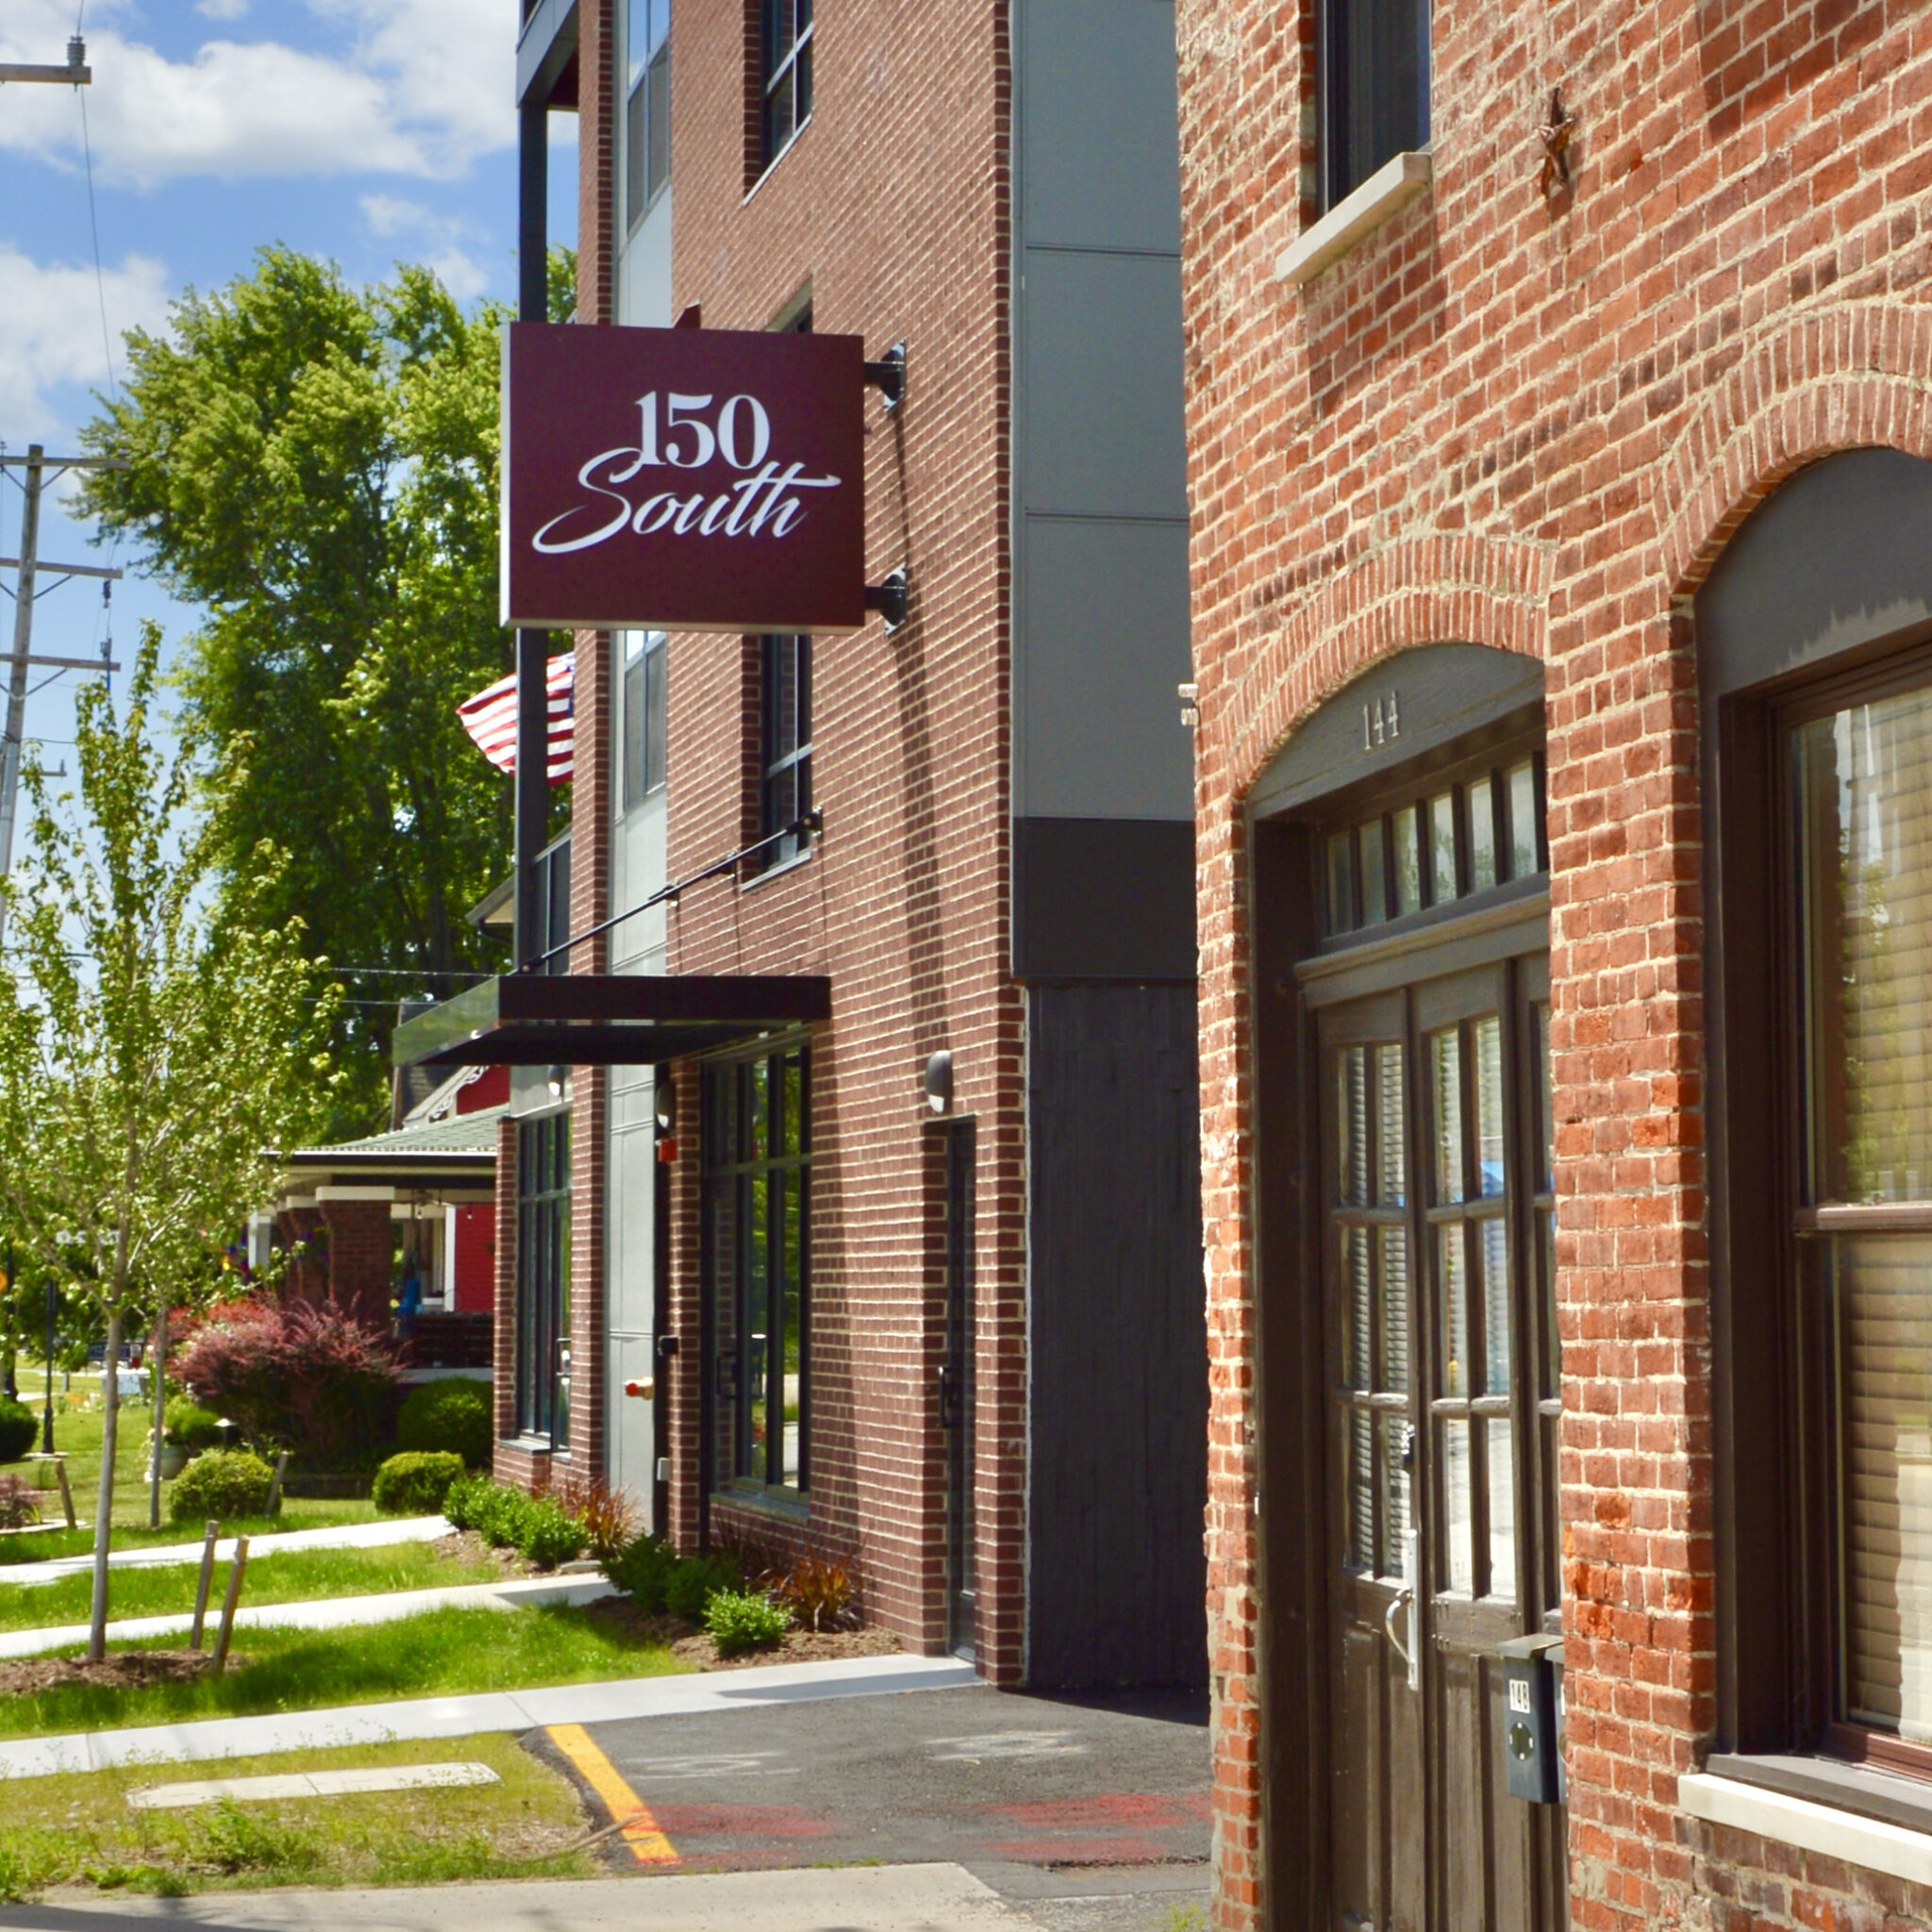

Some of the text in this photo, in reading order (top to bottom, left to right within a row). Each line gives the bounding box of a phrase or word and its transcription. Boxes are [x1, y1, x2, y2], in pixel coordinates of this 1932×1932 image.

[634, 391, 771, 470] 150
[532, 447, 842, 554] South
[1363, 691, 1399, 751] 144
